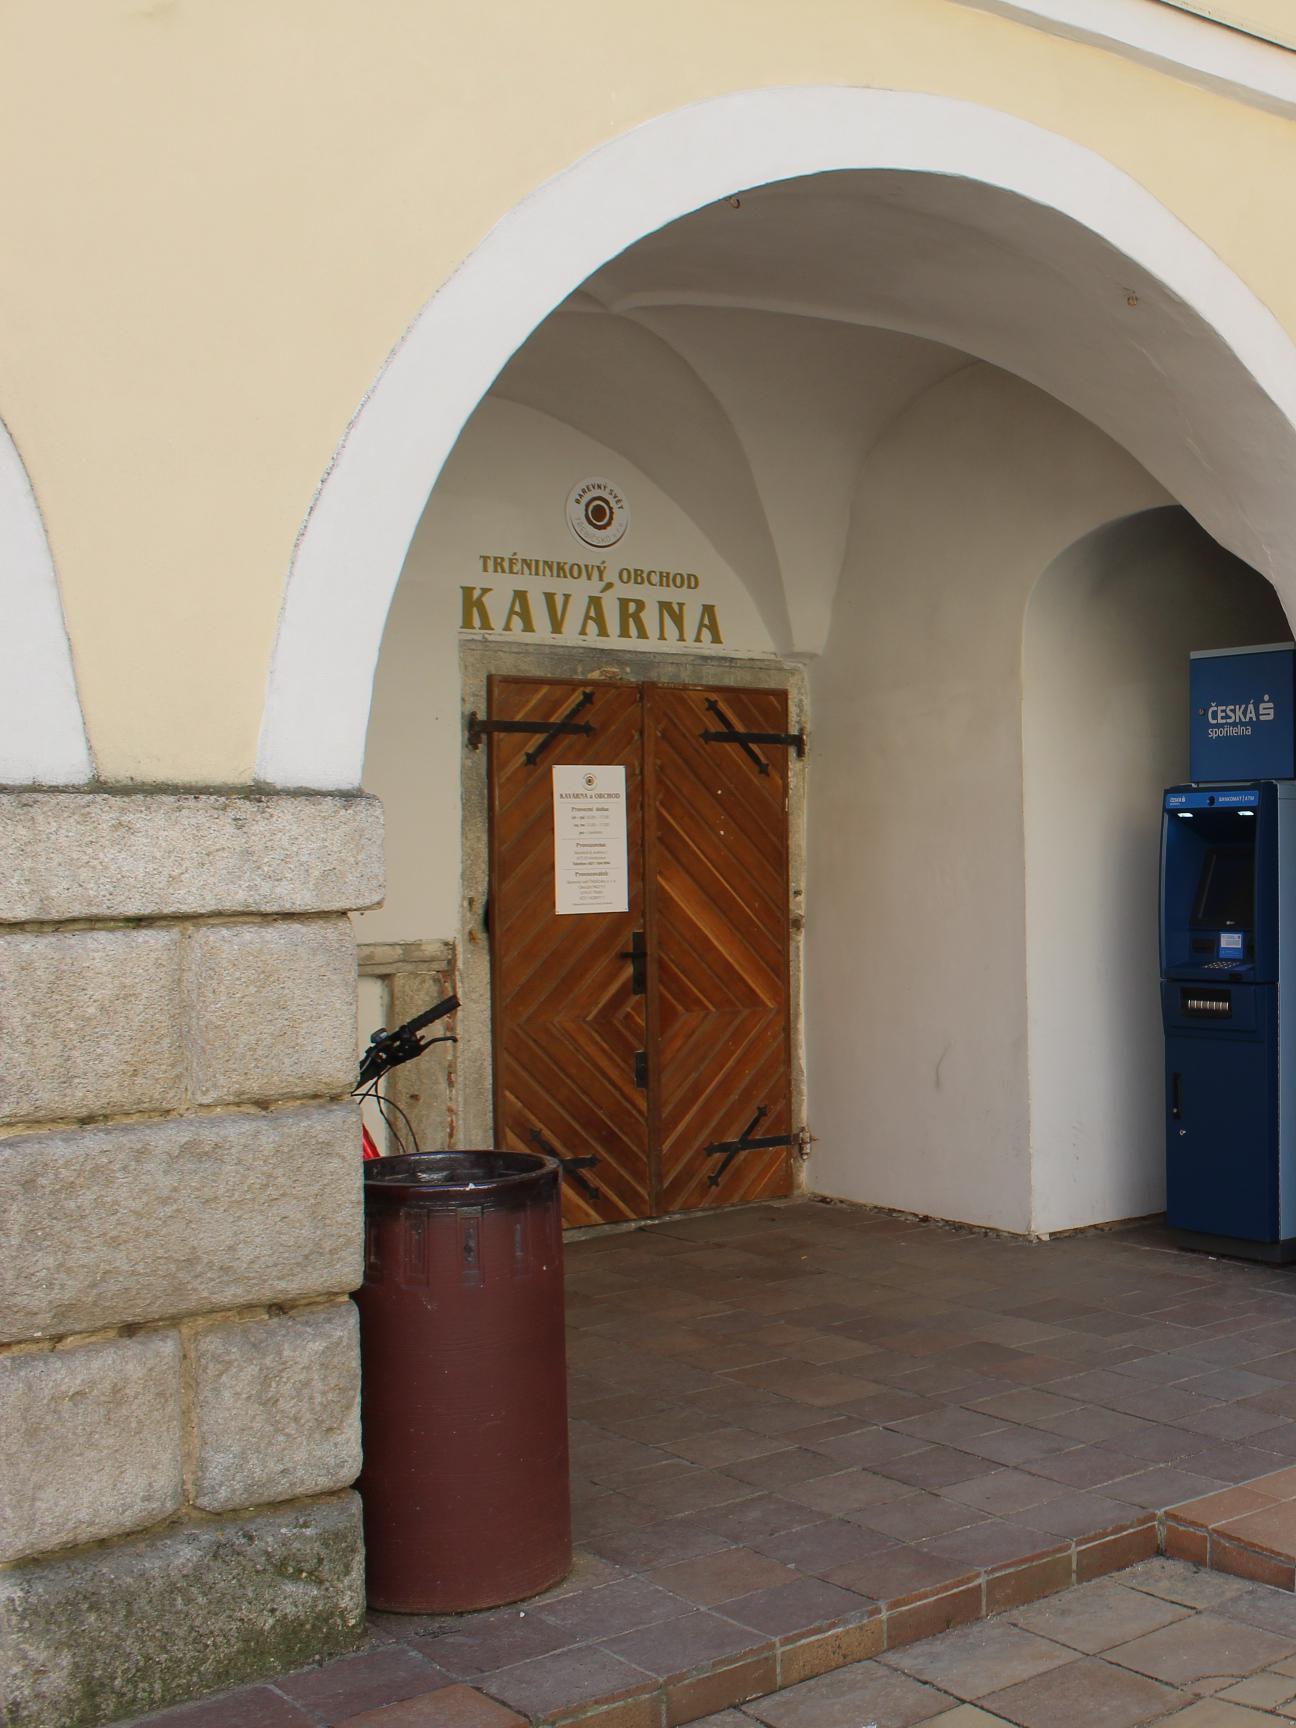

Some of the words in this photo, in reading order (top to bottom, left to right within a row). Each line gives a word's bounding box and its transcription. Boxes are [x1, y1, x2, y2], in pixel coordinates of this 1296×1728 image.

[479, 552, 607, 582] TRÉNINKOVÝ
[618, 567, 700, 590] OBCHOD
[460, 582, 724, 644] KAVÁRNA
[1208, 699, 1256, 724] ČESKÁ
[1208, 725, 1251, 739] spořitelna
